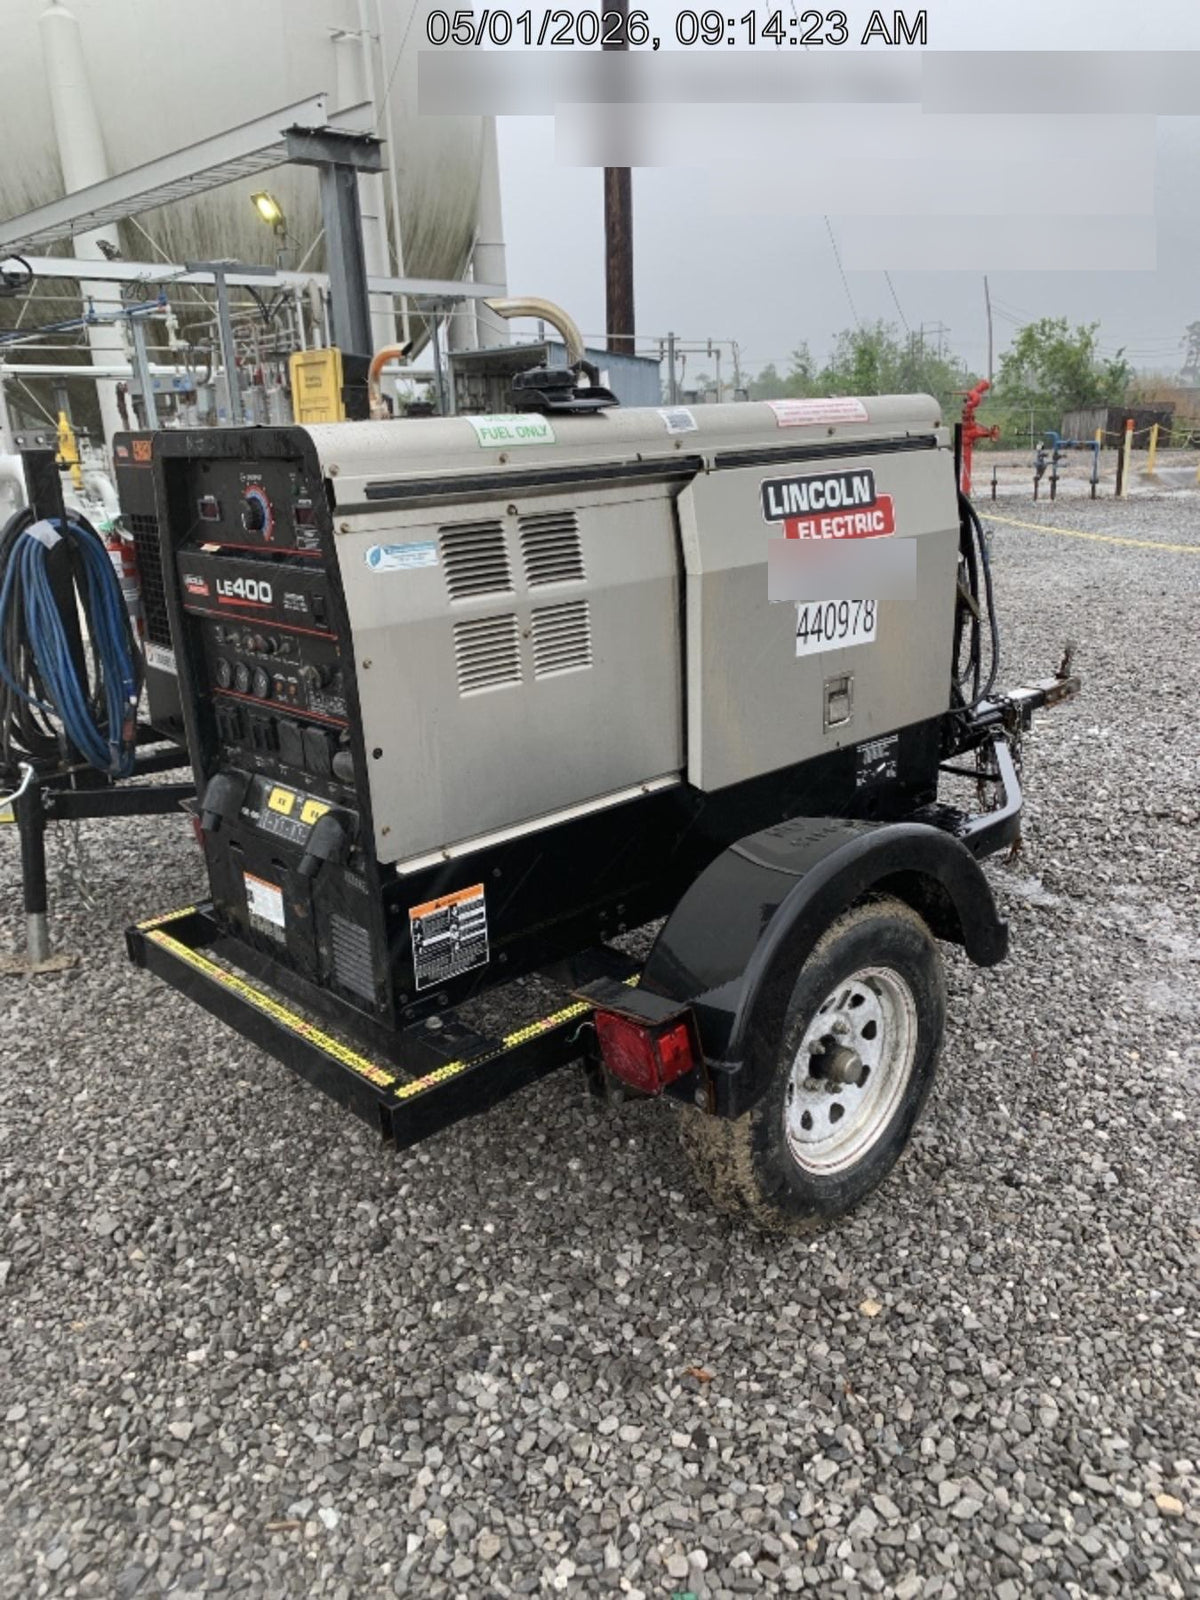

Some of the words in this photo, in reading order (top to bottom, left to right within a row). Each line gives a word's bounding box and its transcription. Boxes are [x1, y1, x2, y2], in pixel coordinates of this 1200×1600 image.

[480, 426, 514, 440] FUEL
[515, 424, 547, 439] ONLY
[767, 475, 872, 516] LINCOLN
[798, 510, 885, 540] ELECTRIC
[216, 577, 273, 604] LE400
[796, 600, 875, 645] 440978
